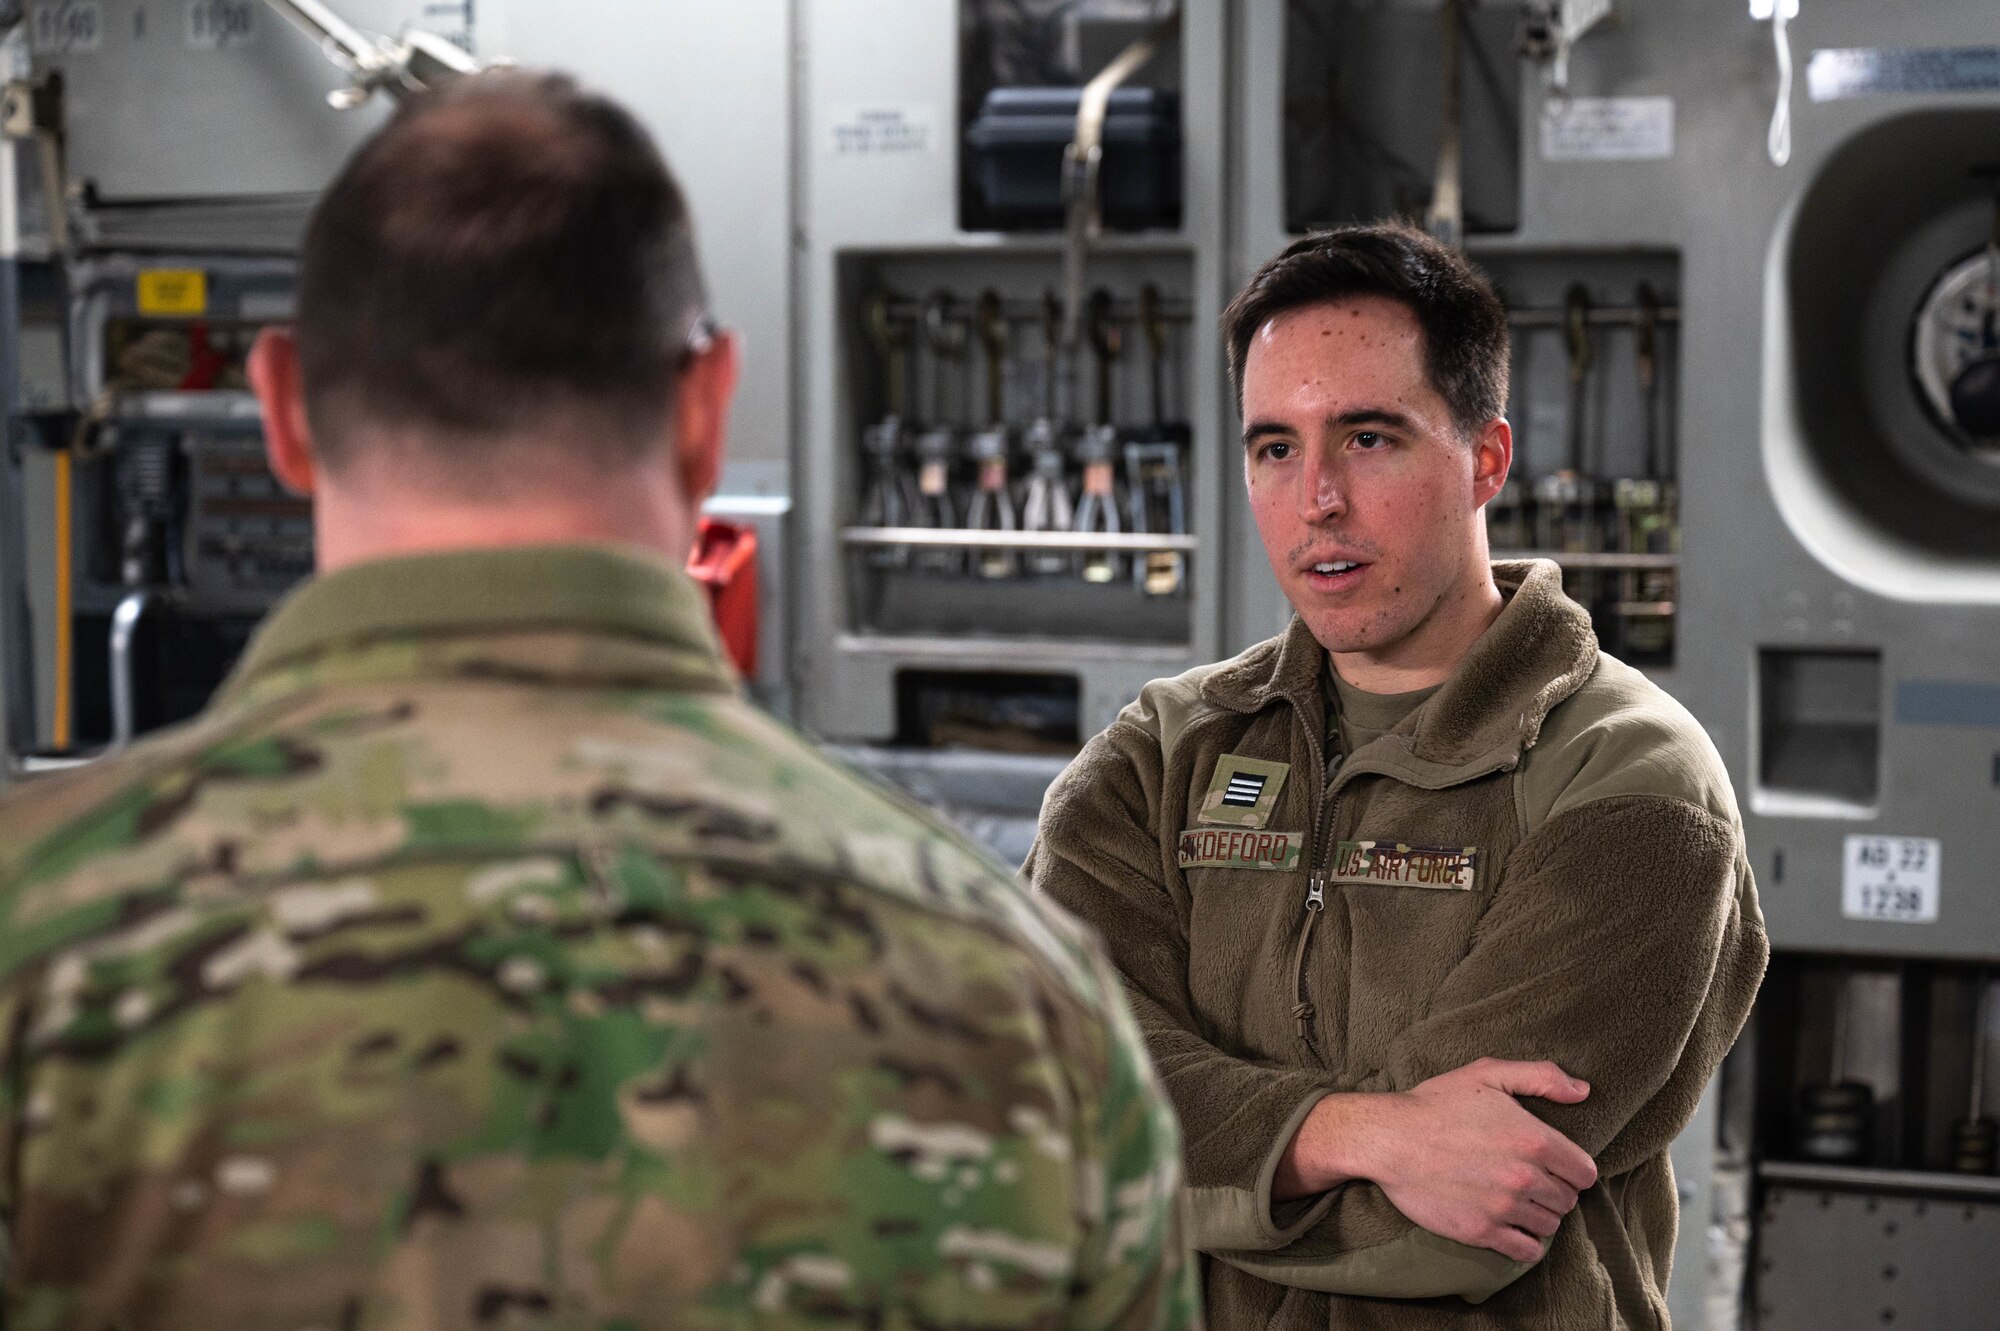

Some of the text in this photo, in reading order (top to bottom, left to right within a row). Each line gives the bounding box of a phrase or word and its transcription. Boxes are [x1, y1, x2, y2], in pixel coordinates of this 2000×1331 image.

[1180, 830, 1289, 864] STEDEFORD
[1337, 848, 1468, 886] U.S. AIR FORCE
